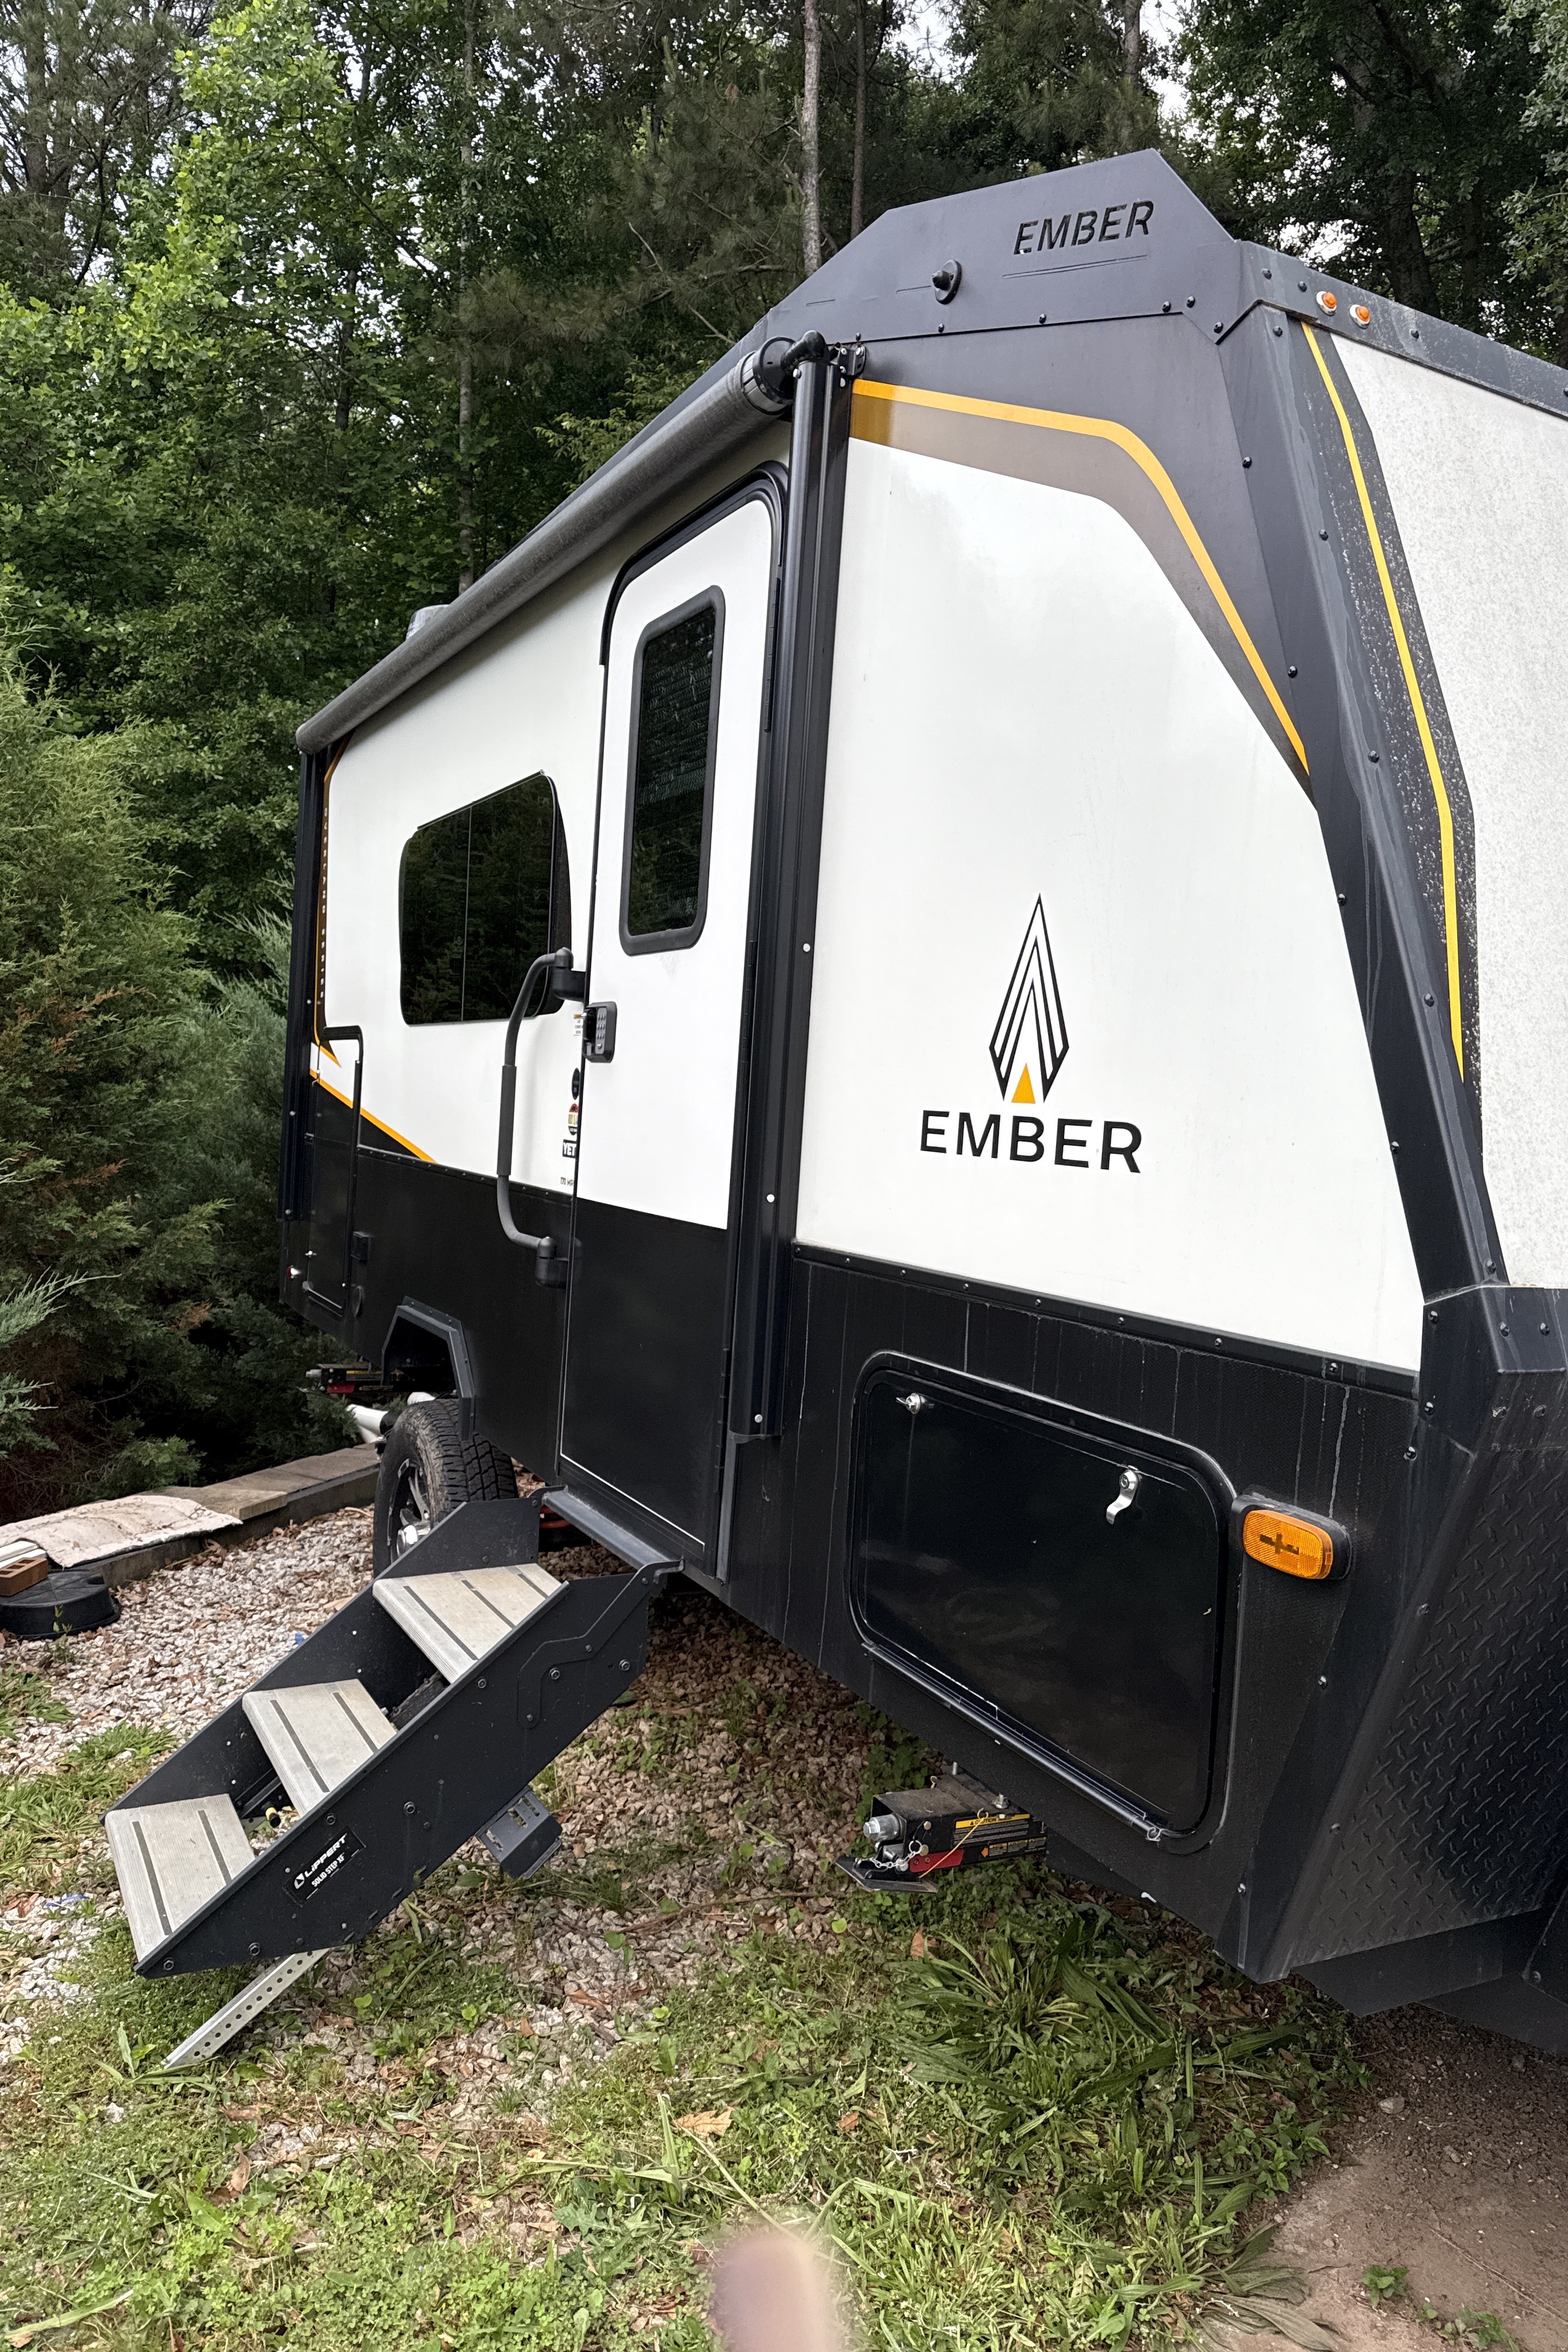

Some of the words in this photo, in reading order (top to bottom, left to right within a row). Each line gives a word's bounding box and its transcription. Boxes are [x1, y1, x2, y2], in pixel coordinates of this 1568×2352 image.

[1013, 200, 1154, 255] EMBER
[921, 1110, 1142, 1174] EMBER
[975, 1817, 996, 1825] CUTION
[312, 1871, 327, 1887] SOLID
[325, 1860, 338, 1874] STEP
[336, 1852, 345, 1864] XF
